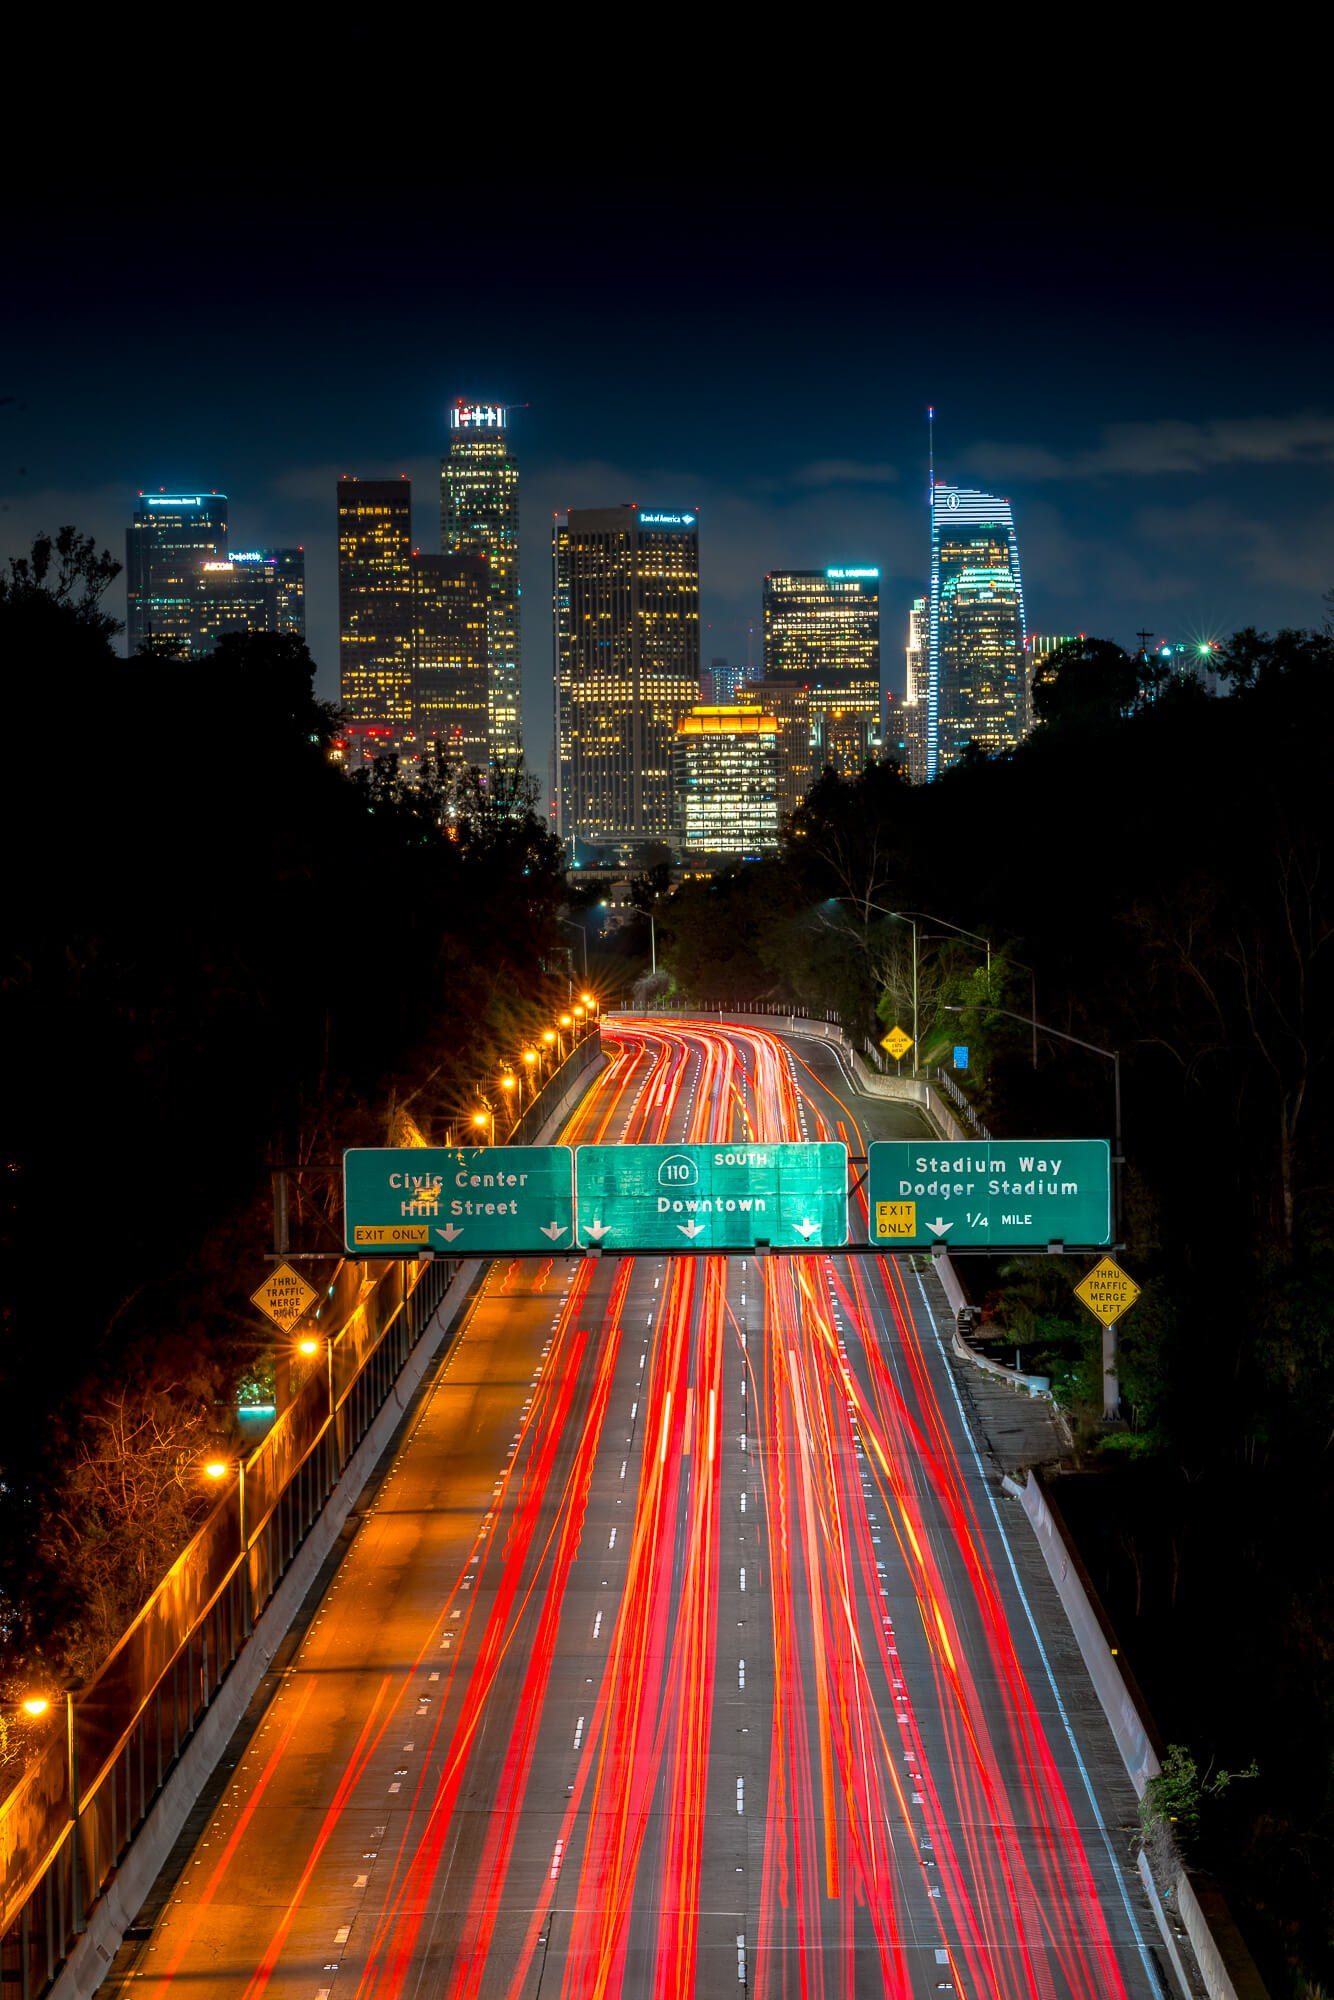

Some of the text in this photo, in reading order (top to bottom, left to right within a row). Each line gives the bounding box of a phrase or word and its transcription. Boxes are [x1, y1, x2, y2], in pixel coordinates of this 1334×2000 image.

[641, 513, 654, 522] Bank
[660, 514, 681, 523] America
[714, 1153, 767, 1166] SOUTH
[916, 1157, 1062, 1176] Stadium Way
[667, 1165, 690, 1180] 110
[389, 1172, 528, 1189] Civic Center
[899, 1180, 1078, 1200] Dodger Stadium
[401, 1200, 518, 1217] Hill Street
[658, 1197, 766, 1213] Downtown
[880, 1206, 913, 1216] EXIT
[966, 1212, 1033, 1228] 1/4 MILE
[879, 1224, 913, 1233] ONLY
[356, 1229, 426, 1240] EXIT ONLY
[1096, 1270, 1120, 1279] THRU
[273, 1277, 297, 1287] THRU
[1089, 1282, 1128, 1290] TRAFFIC
[266, 1288, 304, 1296] TRAFFIC
[1091, 1293, 1126, 1301] MERGE
[270, 1298, 301, 1307] MERGE
[1096, 1304, 1121, 1312] LEFT
